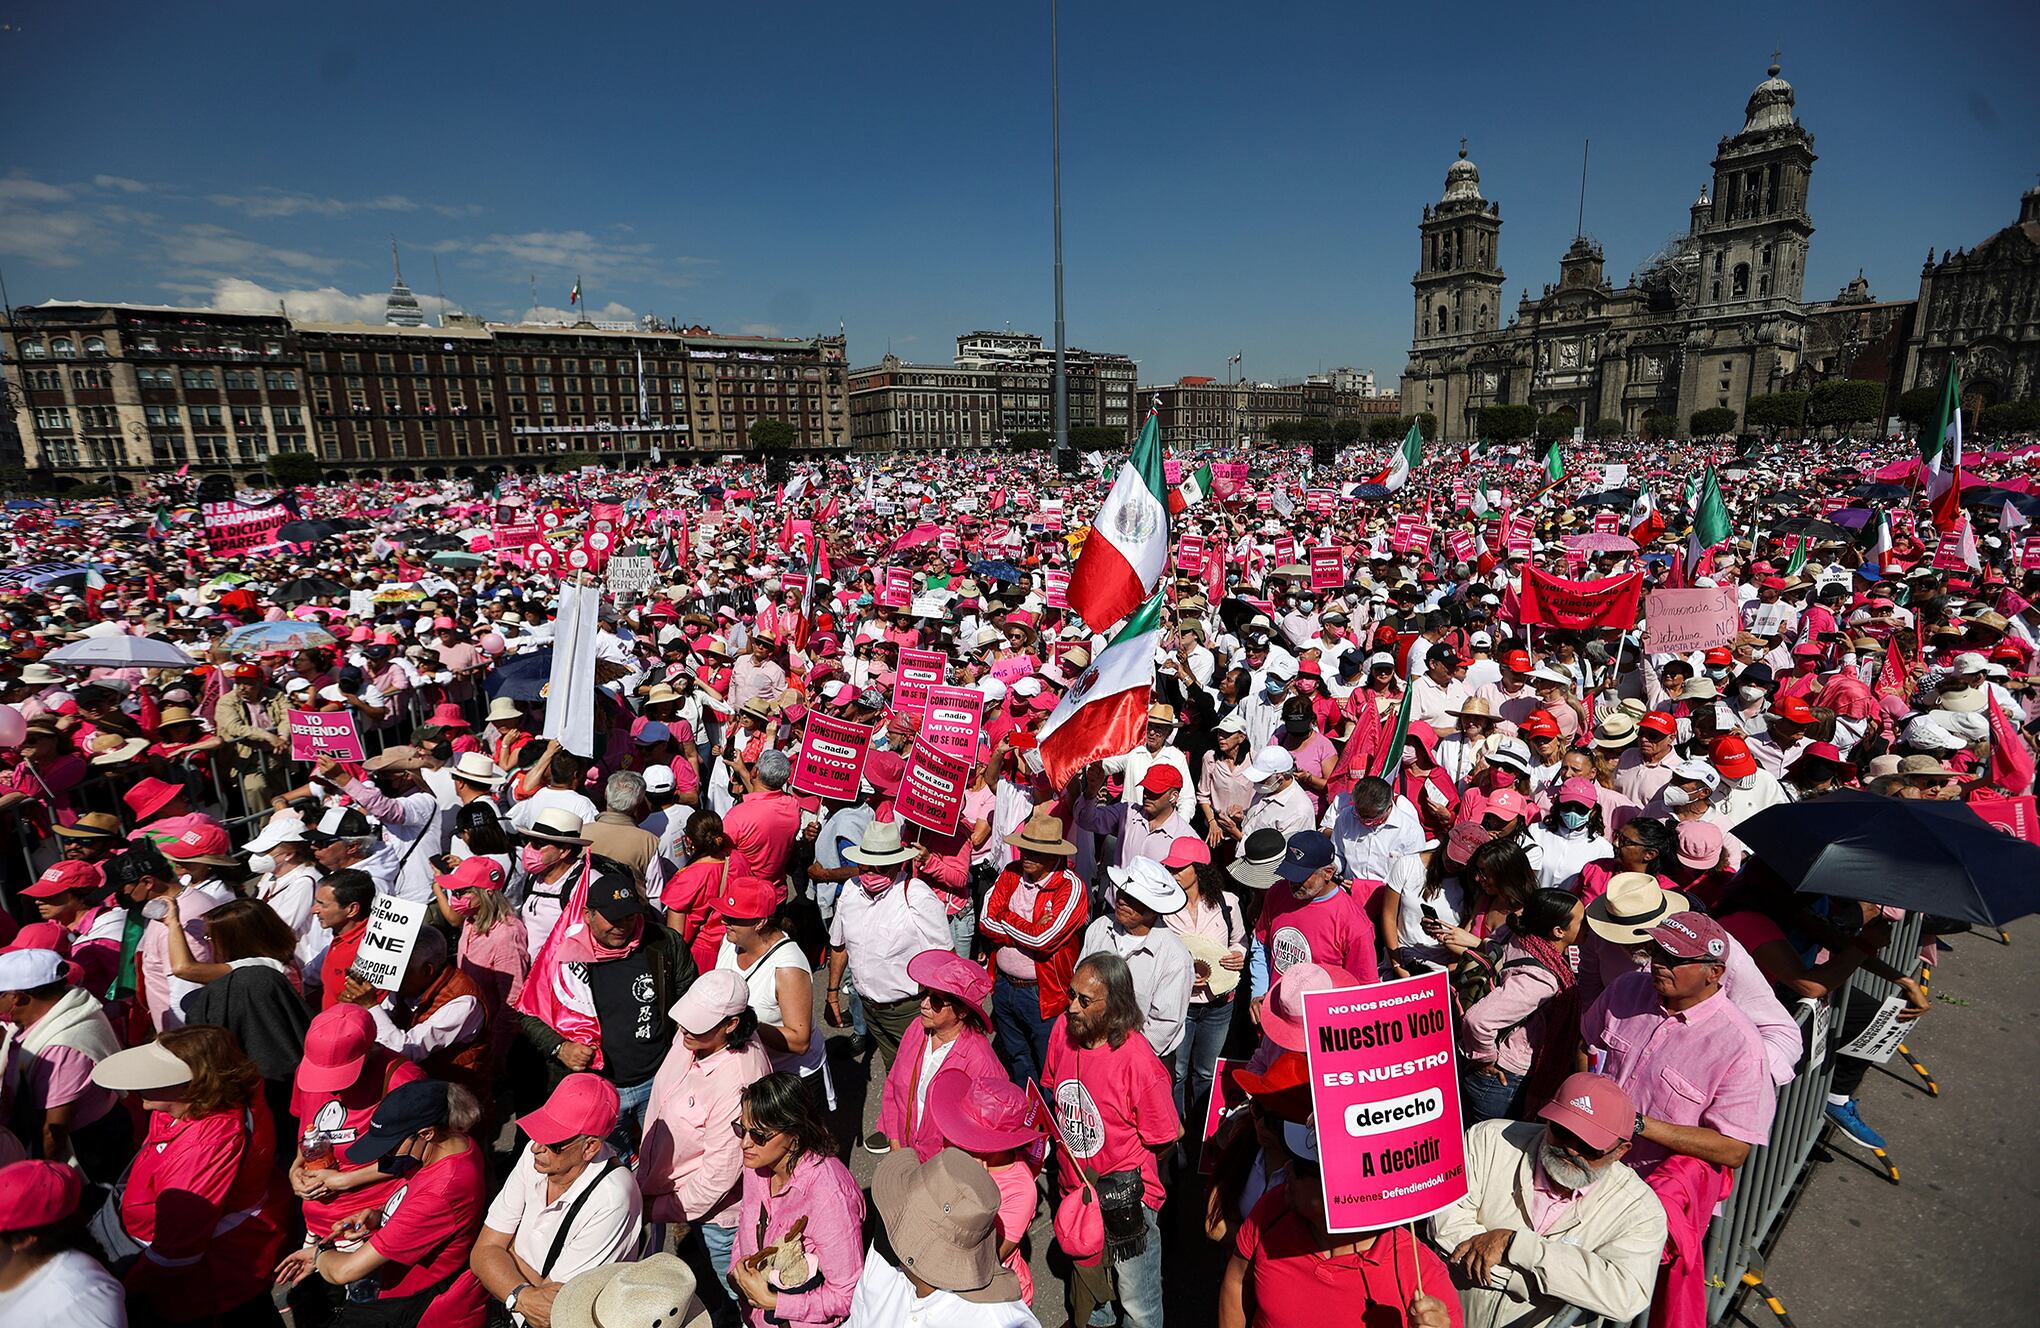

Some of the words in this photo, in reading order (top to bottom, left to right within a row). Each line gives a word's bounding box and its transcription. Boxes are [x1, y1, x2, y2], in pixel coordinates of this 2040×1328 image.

[202, 503, 213, 515] SI
[216, 502, 229, 514] EL
[211, 533, 267, 550] APARECE
[608, 556, 623, 568] SIN
[628, 557, 646, 569] INE
[607, 568, 652, 579] DICTADURA
[1647, 595, 1712, 620] Democracia
[1713, 590, 1728, 613] SÍ
[1646, 623, 1704, 647] Dictadura
[1690, 641, 1700, 650] DE
[901, 657, 943, 670] CONSTITUCIÓN
[992, 669, 1008, 679] mis
[901, 689, 910, 698] NO
[910, 690, 918, 699] SE
[919, 691, 928, 700] TO
[930, 695, 979, 711] CONSTITUCIÓN
[304, 715, 323, 726] YO
[938, 712, 967, 721] ...nadie
[291, 723, 351, 737] DEFIENDO
[810, 723, 866, 746] CONSTITUCIÓN
[928, 723, 943, 731] MI
[943, 725, 974, 735] VOTO
[312, 736, 329, 747] AL
[929, 734, 939, 744] NO
[940, 735, 949, 745] SE
[951, 736, 969, 748] TOCA
[315, 748, 352, 759] INE
[817, 744, 850, 756] ...nadie
[915, 742, 933, 760] CON
[931, 755, 944, 766] EL
[943, 760, 965, 774] INE
[806, 752, 822, 763] MI
[823, 757, 857, 771] VOTO
[915, 751, 927, 767] Que
[927, 760, 960, 782] llegaron
[806, 763, 817, 775] NO
[818, 767, 829, 778] SE
[830, 769, 850, 782] TOCA
[916, 769, 925, 779] en
[925, 774, 933, 783] el
[932, 778, 952, 791] 2018
[906, 775, 958, 804] QUEREMOS
[911, 787, 946, 809] ELEGIR
[905, 795, 915, 807] en
[916, 802, 925, 811] el
[925, 805, 947, 820] 2024
[379, 897, 392, 910] YO
[372, 921, 383, 931] AL
[365, 931, 406, 954] INE
[1328, 1004, 1350, 1016] NO
[1350, 1001, 1378, 1014] NOS
[1378, 989, 1435, 1010] ROBARÁN
[1318, 1019, 1404, 1054] Nuestro
[1406, 1008, 1446, 1040] Voto
[1866, 1026, 1901, 1056] INE
[1323, 1071, 1355, 1087] ES
[1357, 1050, 1450, 1085] NUESTRO
[1356, 1097, 1437, 1128] derecho
[1569, 1099, 1594, 1115] adidas
[1362, 1151, 1376, 1179] A
[1379, 1136, 1442, 1176] decidir
